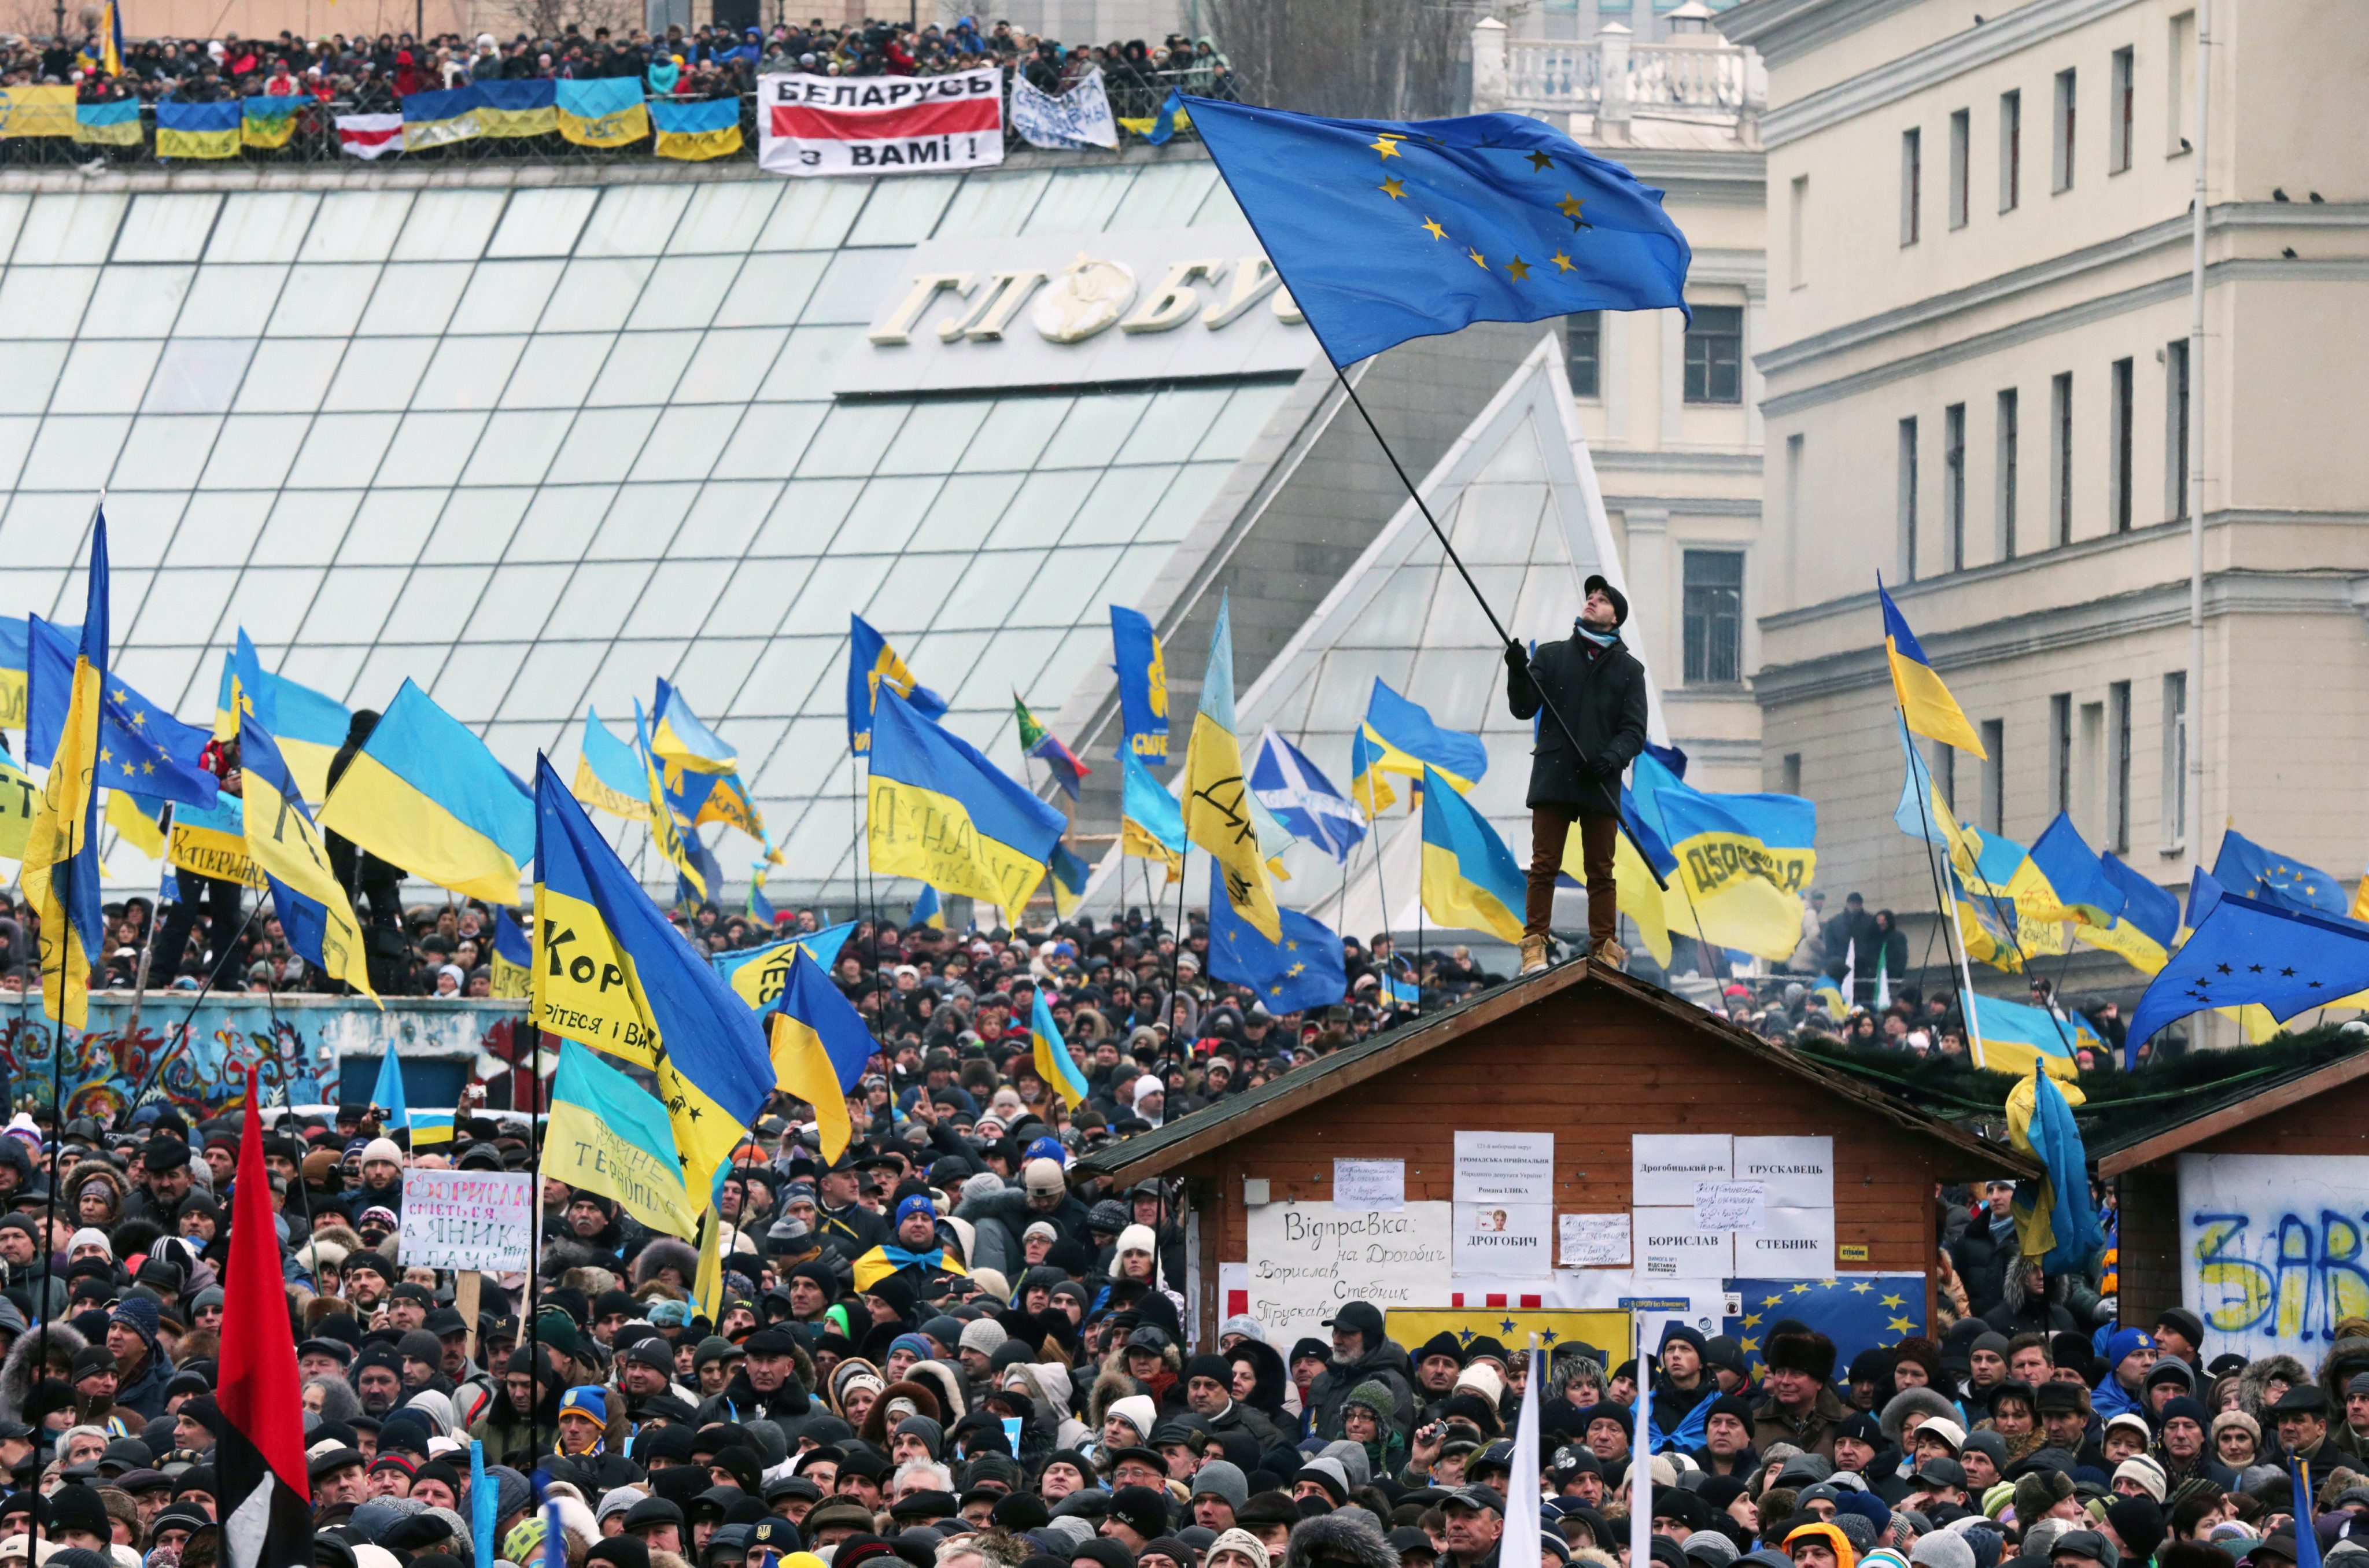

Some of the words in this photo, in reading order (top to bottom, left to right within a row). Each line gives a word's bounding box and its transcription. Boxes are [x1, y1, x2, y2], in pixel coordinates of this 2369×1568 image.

[777, 75, 993, 108] БЕЛАРУСЬ
[968, 137, 977, 159] !
[1640, 1163, 1706, 1173] Дрогобицький
[1708, 1164, 1726, 1173] р-н.
[1748, 1164, 1823, 1175] ТРУСКАВЕЦЬ
[424, 1217, 516, 1248] ЯНИК
[1285, 1212, 1417, 1251] Відправка:
[1467, 1235, 1537, 1247] ДРОГОБИЧ
[1648, 1235, 1719, 1246] БОРИСЛАВ
[1755, 1239, 1818, 1249] СТЕБНИК
[1337, 1249, 1358, 1263] на
[1366, 1243, 1445, 1268] Дрогобич
[1256, 1260, 1339, 1285] Борислав
[1333, 1280, 1410, 1301] Стебник
